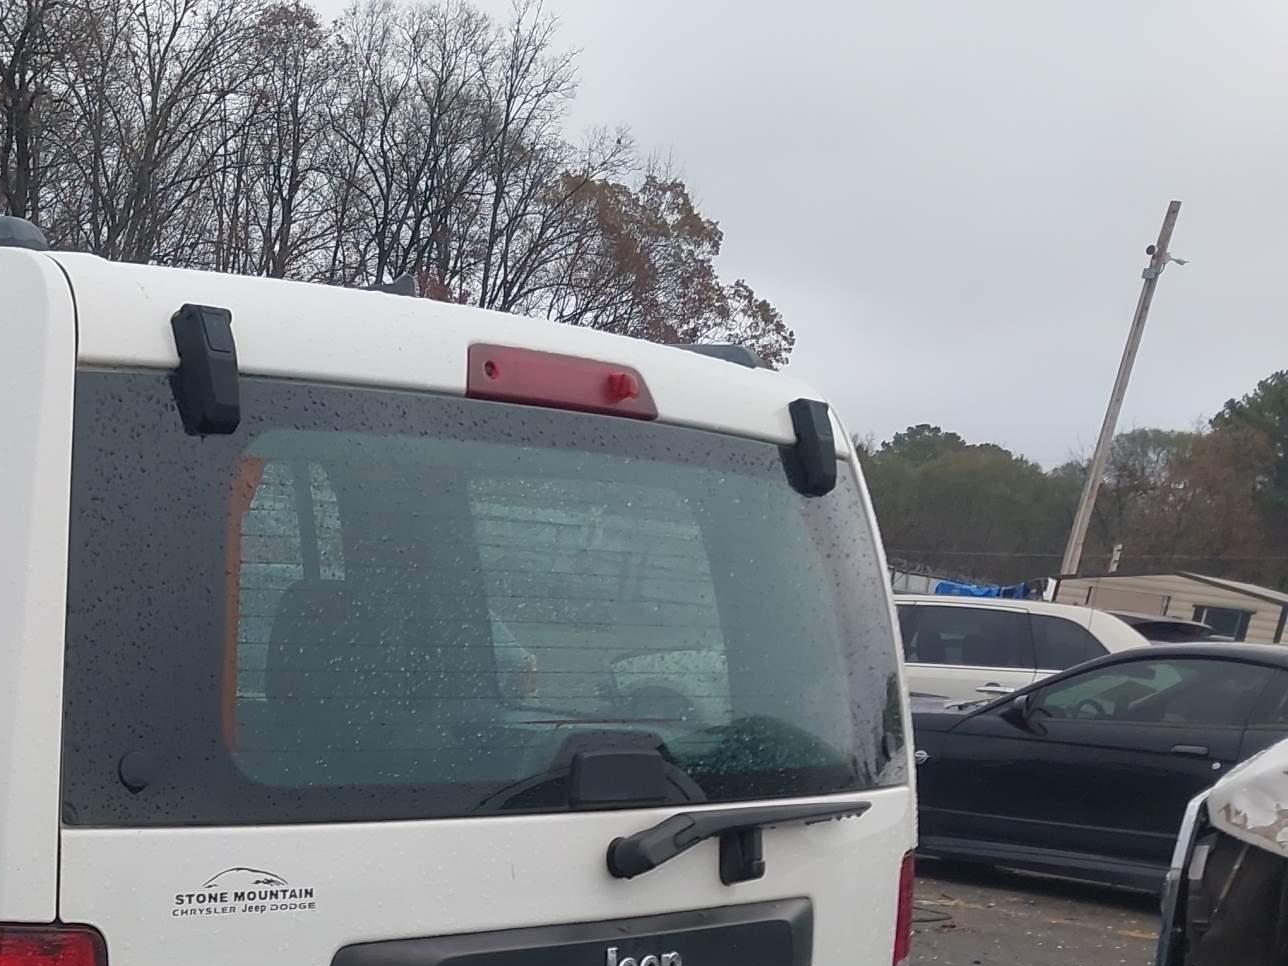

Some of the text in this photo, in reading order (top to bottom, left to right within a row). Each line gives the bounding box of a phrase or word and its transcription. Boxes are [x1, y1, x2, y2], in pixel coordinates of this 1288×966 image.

[174, 888, 314, 905] STONE MOUNTAIN
[172, 902, 316, 917] CHRYSLER Jeep DODGE
